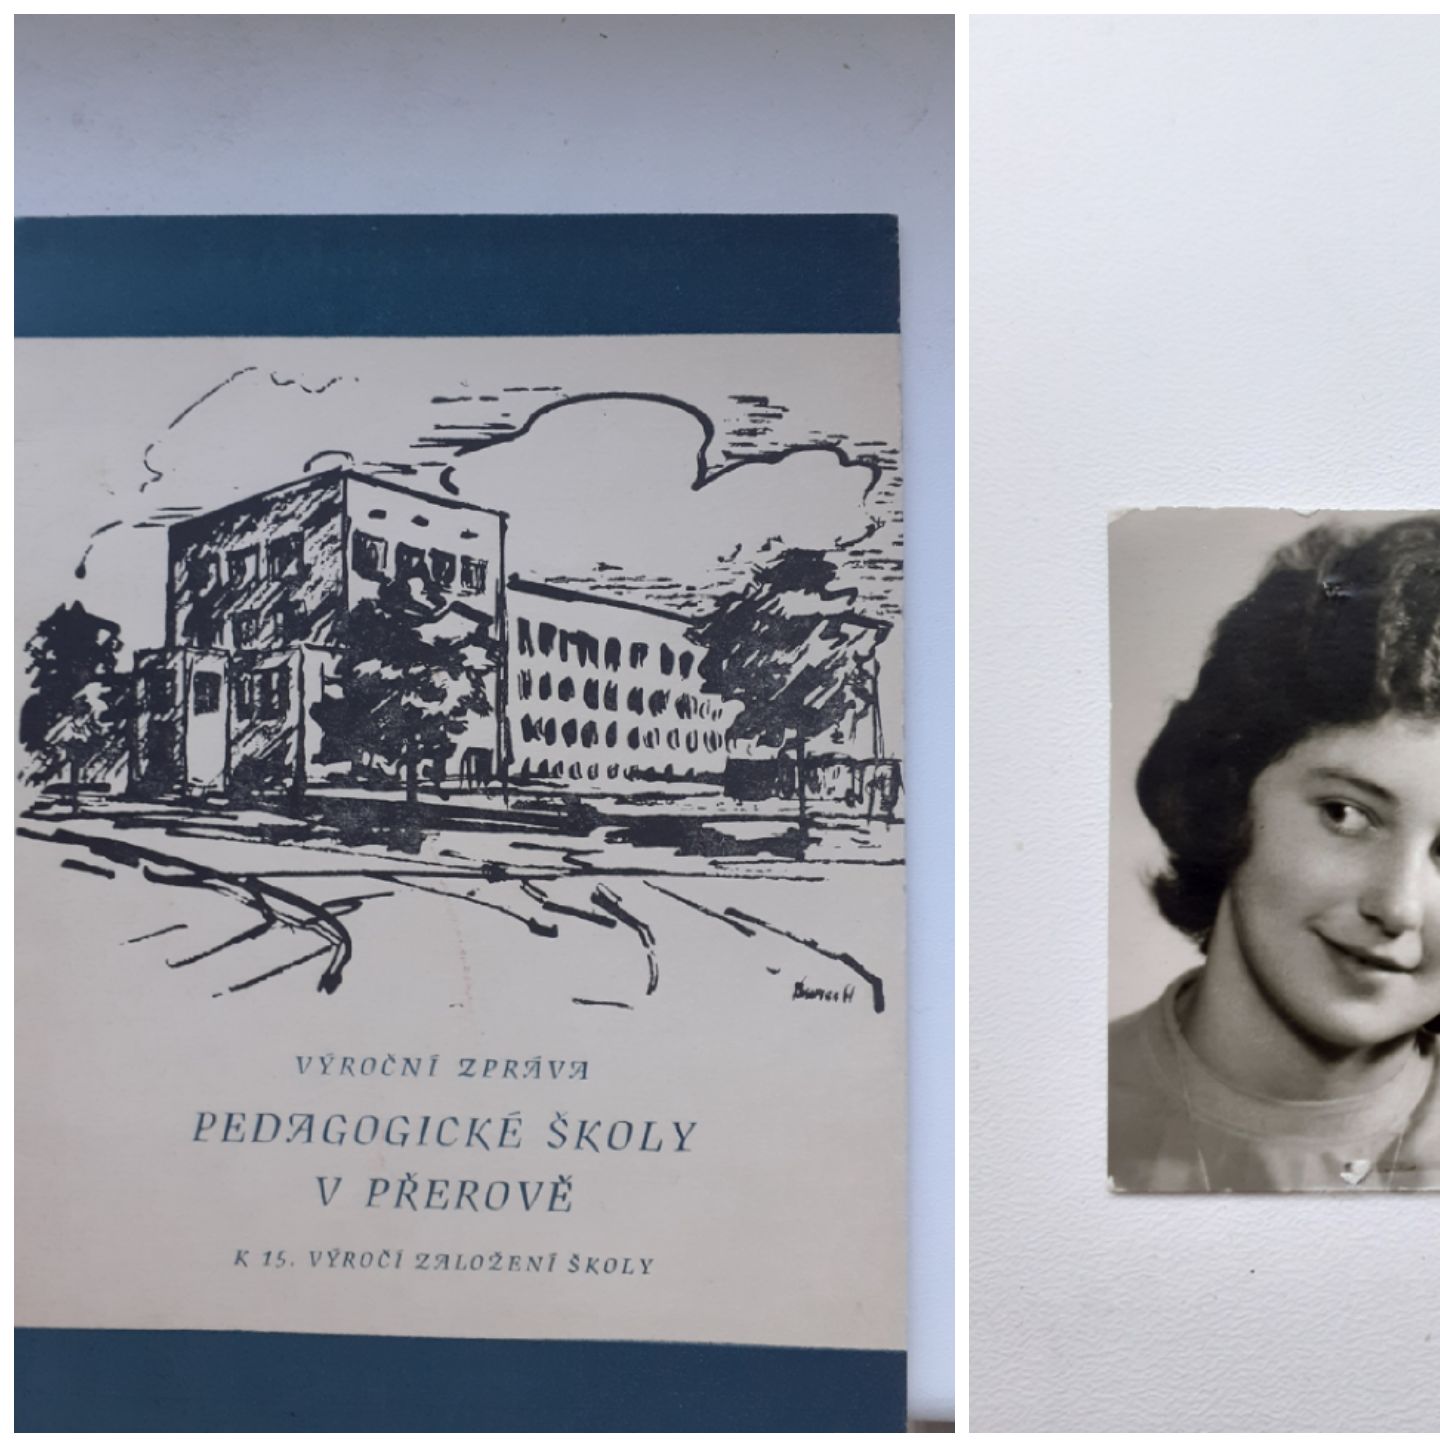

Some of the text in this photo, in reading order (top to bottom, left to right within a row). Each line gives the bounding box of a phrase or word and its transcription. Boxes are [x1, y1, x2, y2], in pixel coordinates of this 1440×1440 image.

[295, 1052, 589, 1081] VÝROČNÍ ZPRÁVA
[192, 1110, 698, 1153] PEDAGOGICKÉ ŠKOLY
[315, 1171, 573, 1213] V PŘEROVĚ
[233, 1247, 654, 1276] K 15. VÝROČÍ ZALOŽENÍ ŠKOLY
